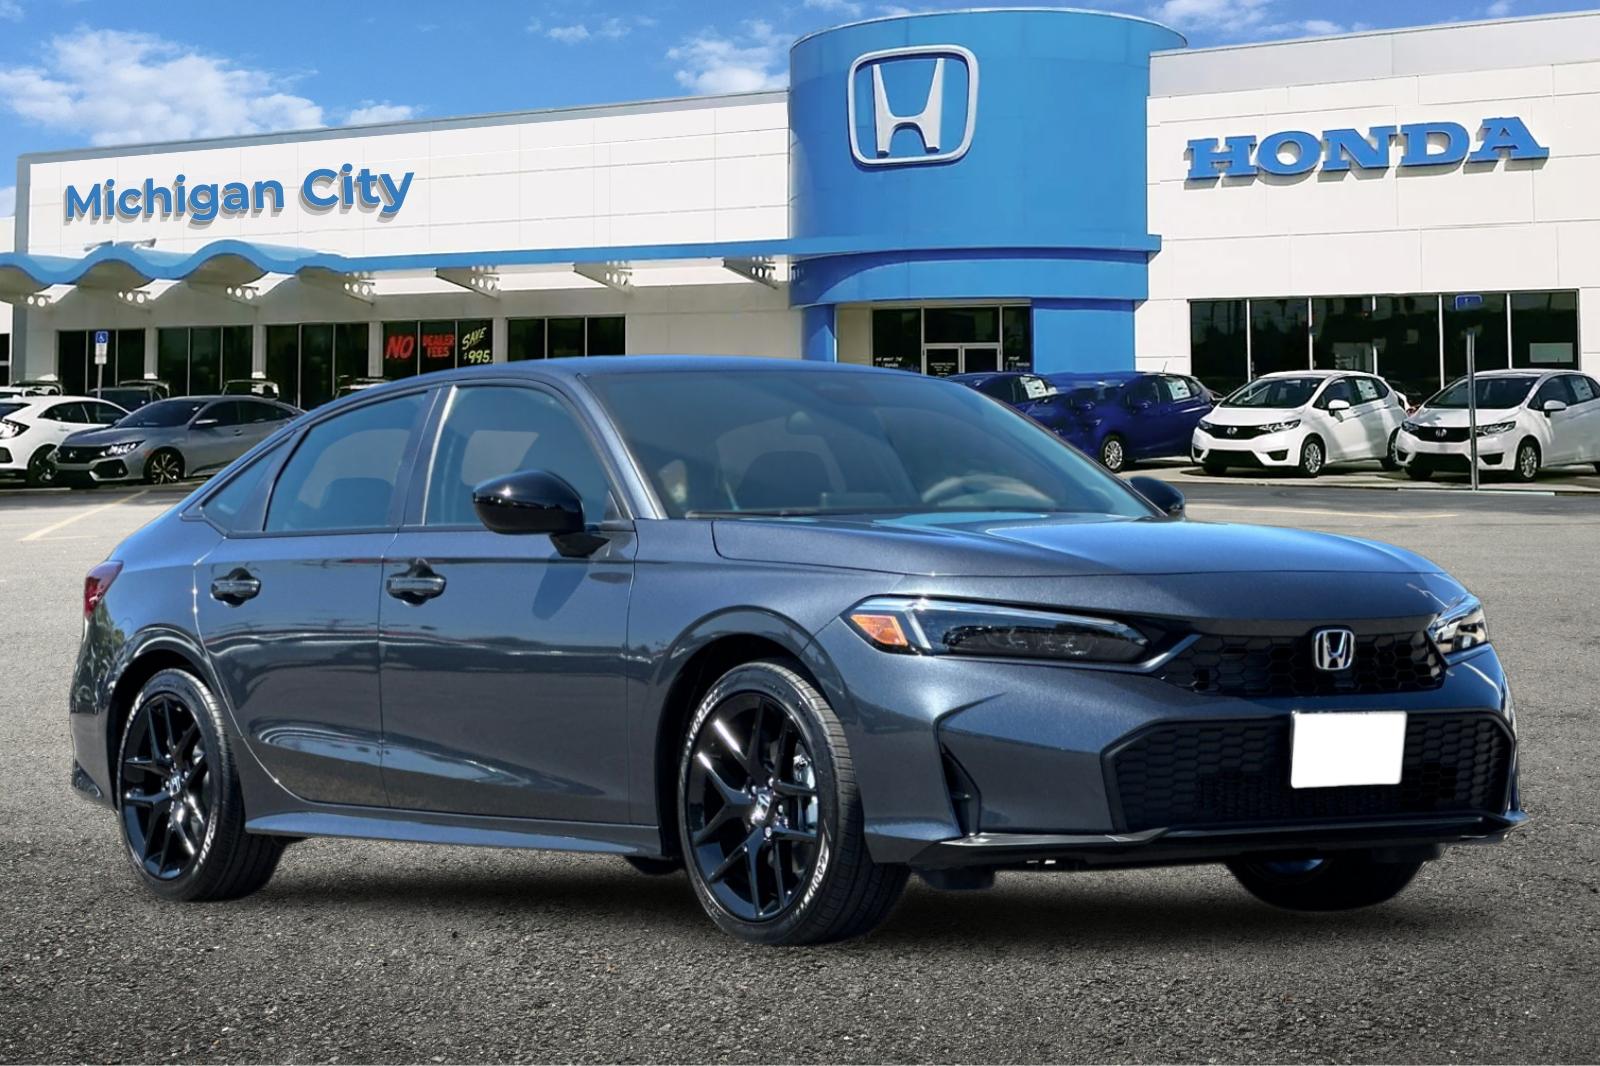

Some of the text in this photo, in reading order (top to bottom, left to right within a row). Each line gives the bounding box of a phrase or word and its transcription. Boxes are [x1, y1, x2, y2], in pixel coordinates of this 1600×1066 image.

[1186, 116, 1550, 182] HONDA
[65, 163, 415, 222] Michigan City
[385, 335, 415, 359] NO
[462, 326, 487, 350] SAVE
